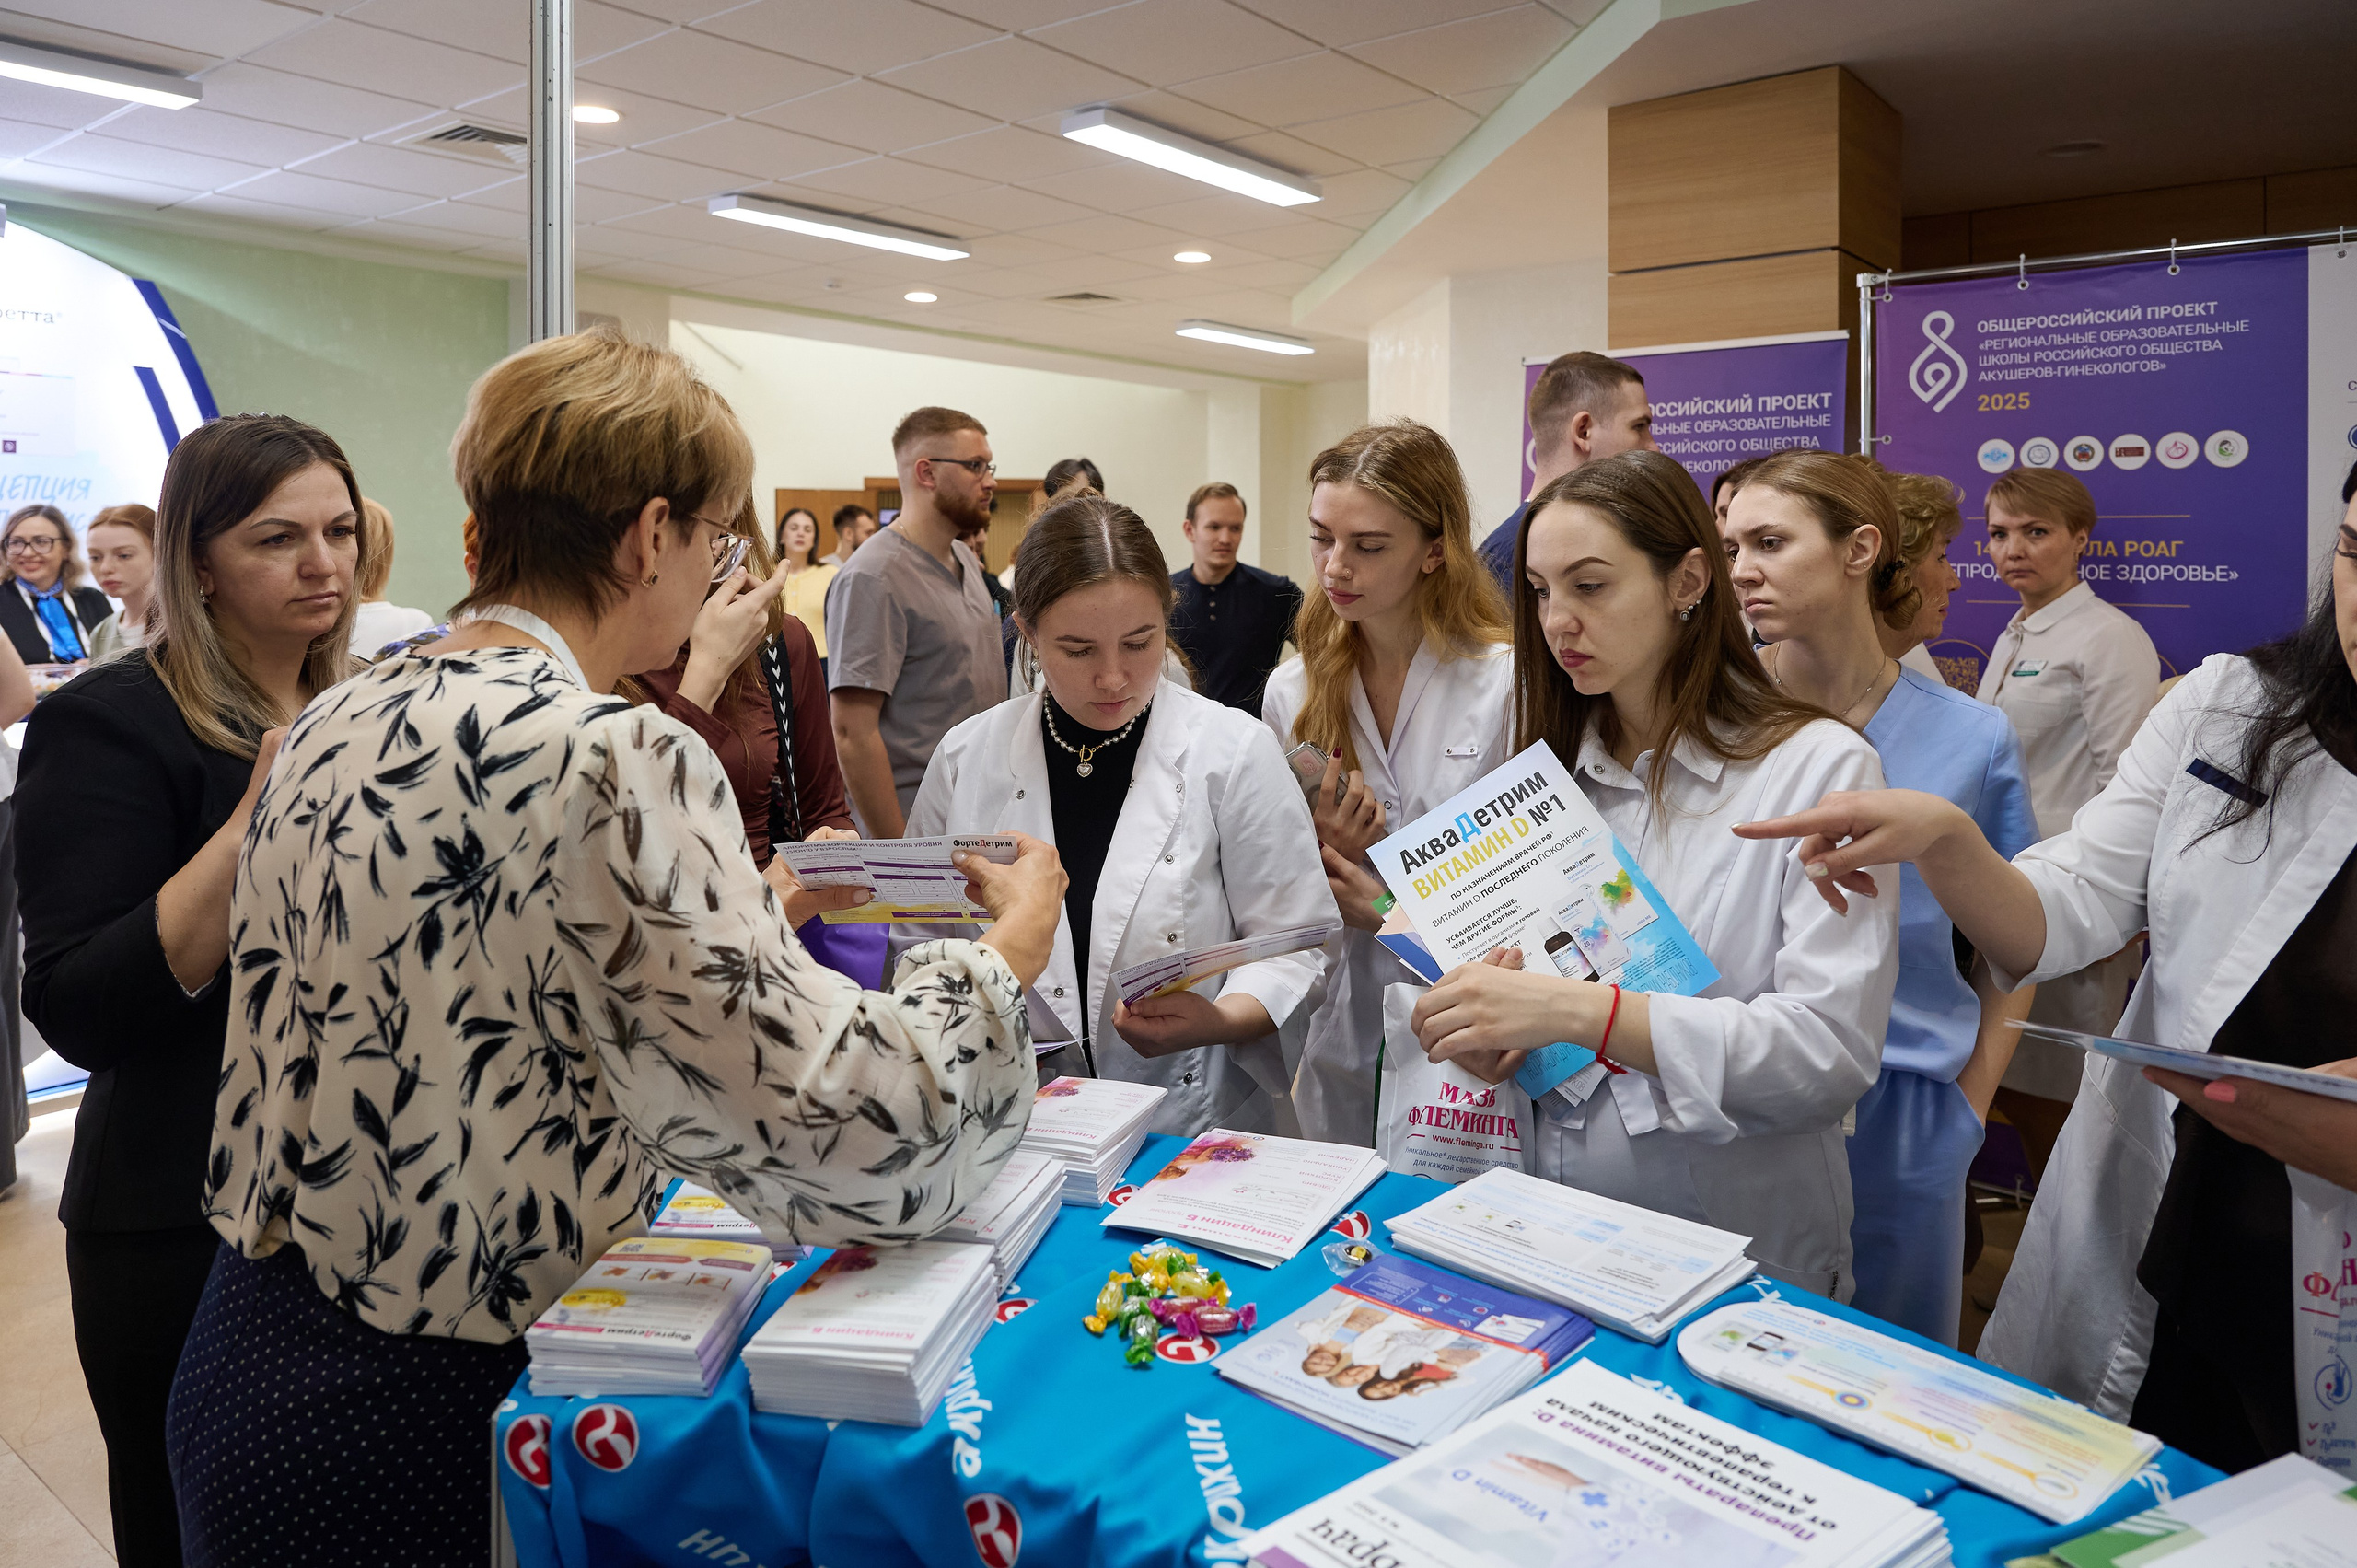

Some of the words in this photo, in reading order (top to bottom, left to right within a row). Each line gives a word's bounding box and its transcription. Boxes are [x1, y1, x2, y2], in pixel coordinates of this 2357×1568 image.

[1977, 305, 2142, 333] ОБЩЕРОССИЙСКИЙ
[2146, 301, 2219, 320] ПРОЕКТ
[1979, 331, 2097, 351] «РЕГИОНАЛЬНЫЕ
[2100, 319, 2250, 343] ОБРАЗОВАТЕЛЬНЫЕ
[1979, 352, 2030, 366] ШКОЛЫ
[2033, 344, 2137, 364] РОССИЙСКОГО
[2139, 339, 2223, 356] ОБЩЕСТВА
[1978, 360, 2166, 382] АКУШЕРОВ-ГИНЕКОЛОГОВ»
[1757, 392, 1833, 412] ПРОЕКТ
[1977, 392, 2030, 412] 2025
[1693, 413, 1832, 433] ОБРАЗОВАТЕЛЬНЫЕ
[1739, 435, 1820, 452] ОБЩЕСТВА
[2124, 540, 2184, 557] РОАГ
[2116, 564, 2239, 585] ЗДОРОВЬЕ»
[1399, 771, 1549, 875] АкваДетрим
[953, 839, 1013, 849] ФортеДетрим
[1412, 826, 1514, 900] ВИТАМИН
[1510, 817, 1529, 838] D
[1527, 794, 1566, 827] №1
[1432, 900, 1474, 928] ВИТАМИН
[1473, 894, 1481, 903] D
[1480, 858, 1538, 899] ПОСЛЕДНЕГО
[1538, 825, 1589, 862] ПОКОЛЕНИЯ
[1450, 890, 1462, 900] ПО
[1462, 856, 1515, 894] НАЗНАЧЕНИЯМ
[1514, 841, 1544, 862] ВРАЧЕЙ
[1562, 852, 1596, 876] АкваДетрим
[1446, 912, 1492, 944] УСВАИВАЕТСЯ
[1492, 898, 1518, 917] ЛУЧШЕ,
[1451, 939, 1467, 950] ЧЕМ
[1468, 924, 1492, 943] ДРУГИЕ
[1438, 1081, 1497, 1109] МАЗЬ
[1408, 1105, 1519, 1139] ФЛЕМИНГА
[1433, 1134, 1494, 1151] www.fleminga.ru
[1427, 1161, 1455, 1172] каждой
[1446, 1154, 1490, 1167] лекарственное
[1491, 1159, 1519, 1169] средство
[1201, 1216, 1294, 1244] Клиндацин
[1532, 1408, 1554, 1423] D:
[1546, 1397, 1620, 1434] начала
[1560, 1420, 1668, 1474] витамина
[1589, 1400, 1793, 1497] терапевтическим
[1652, 1411, 1776, 1470] эффектам
[1451, 1469, 1472, 1482] D
[1626, 1432, 1807, 1516] действующего
[1475, 1476, 1550, 1523] Vitamin
[1673, 1472, 1817, 1542] Препараты
[1803, 1494, 1818, 1505] к
[1808, 1512, 1839, 1531] от
